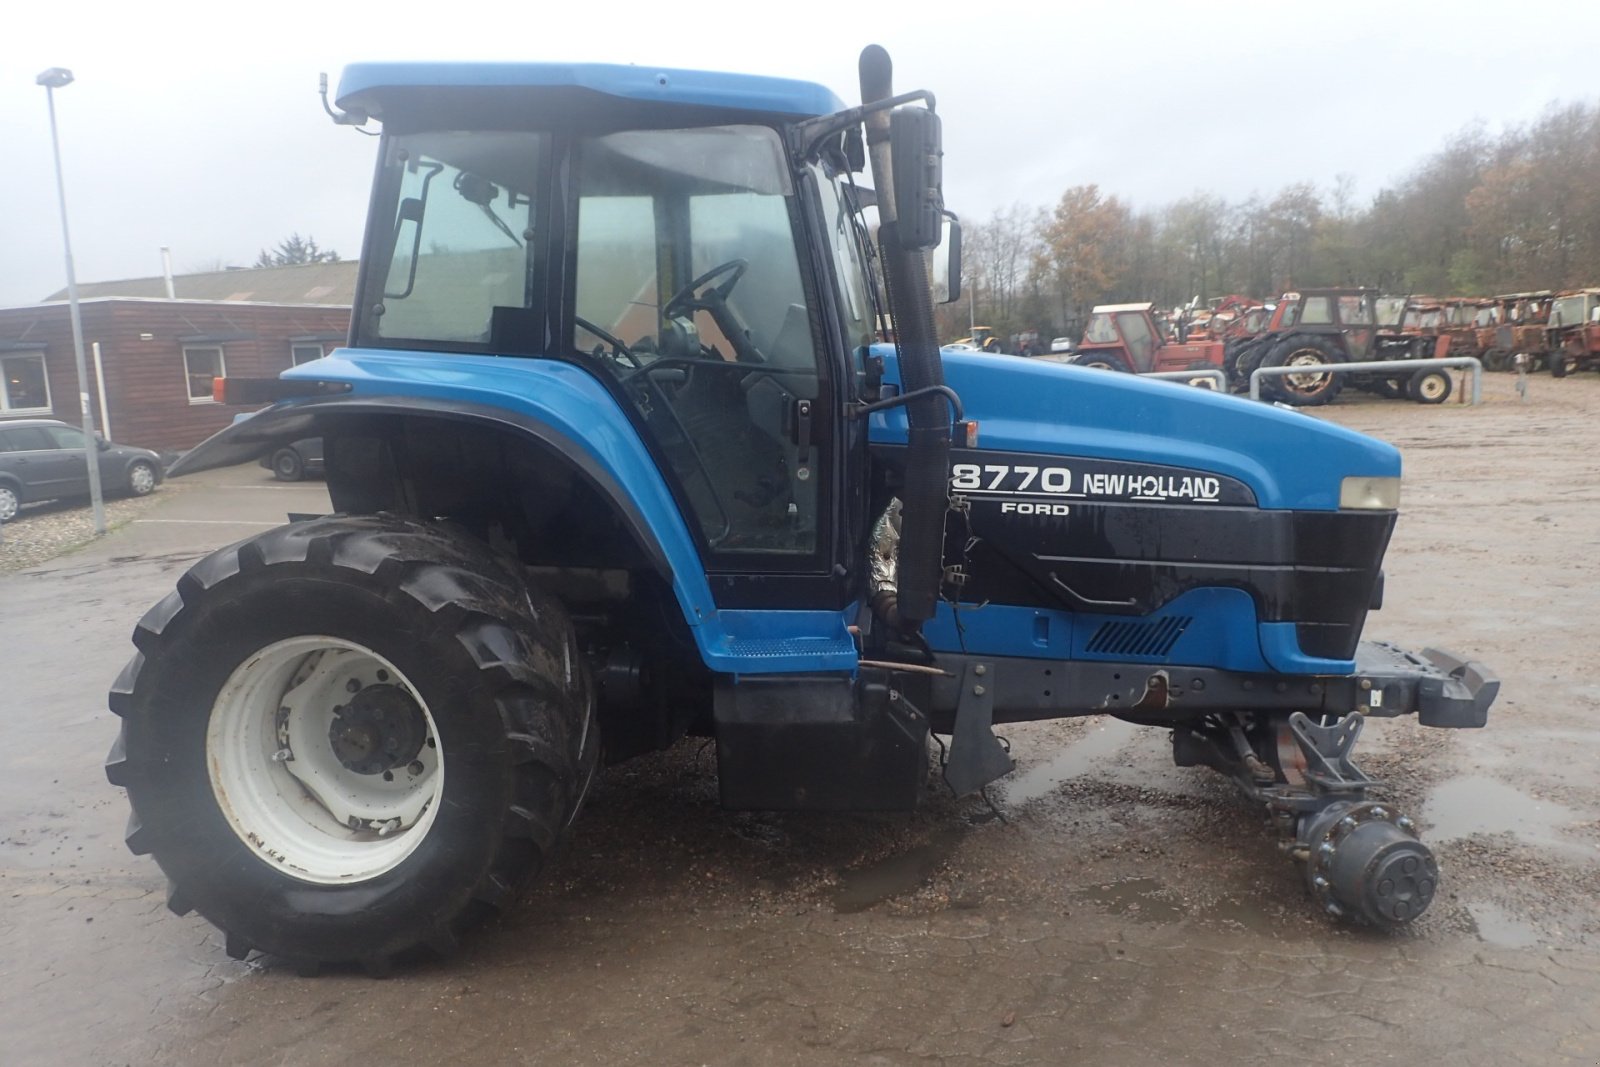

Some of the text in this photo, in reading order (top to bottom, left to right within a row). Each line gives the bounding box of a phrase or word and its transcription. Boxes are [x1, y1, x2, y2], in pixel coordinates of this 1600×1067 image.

[952, 464, 1072, 492] 8770
[1083, 474, 1220, 498] NEW HOLLAND
[1001, 503, 1069, 516] FORD
